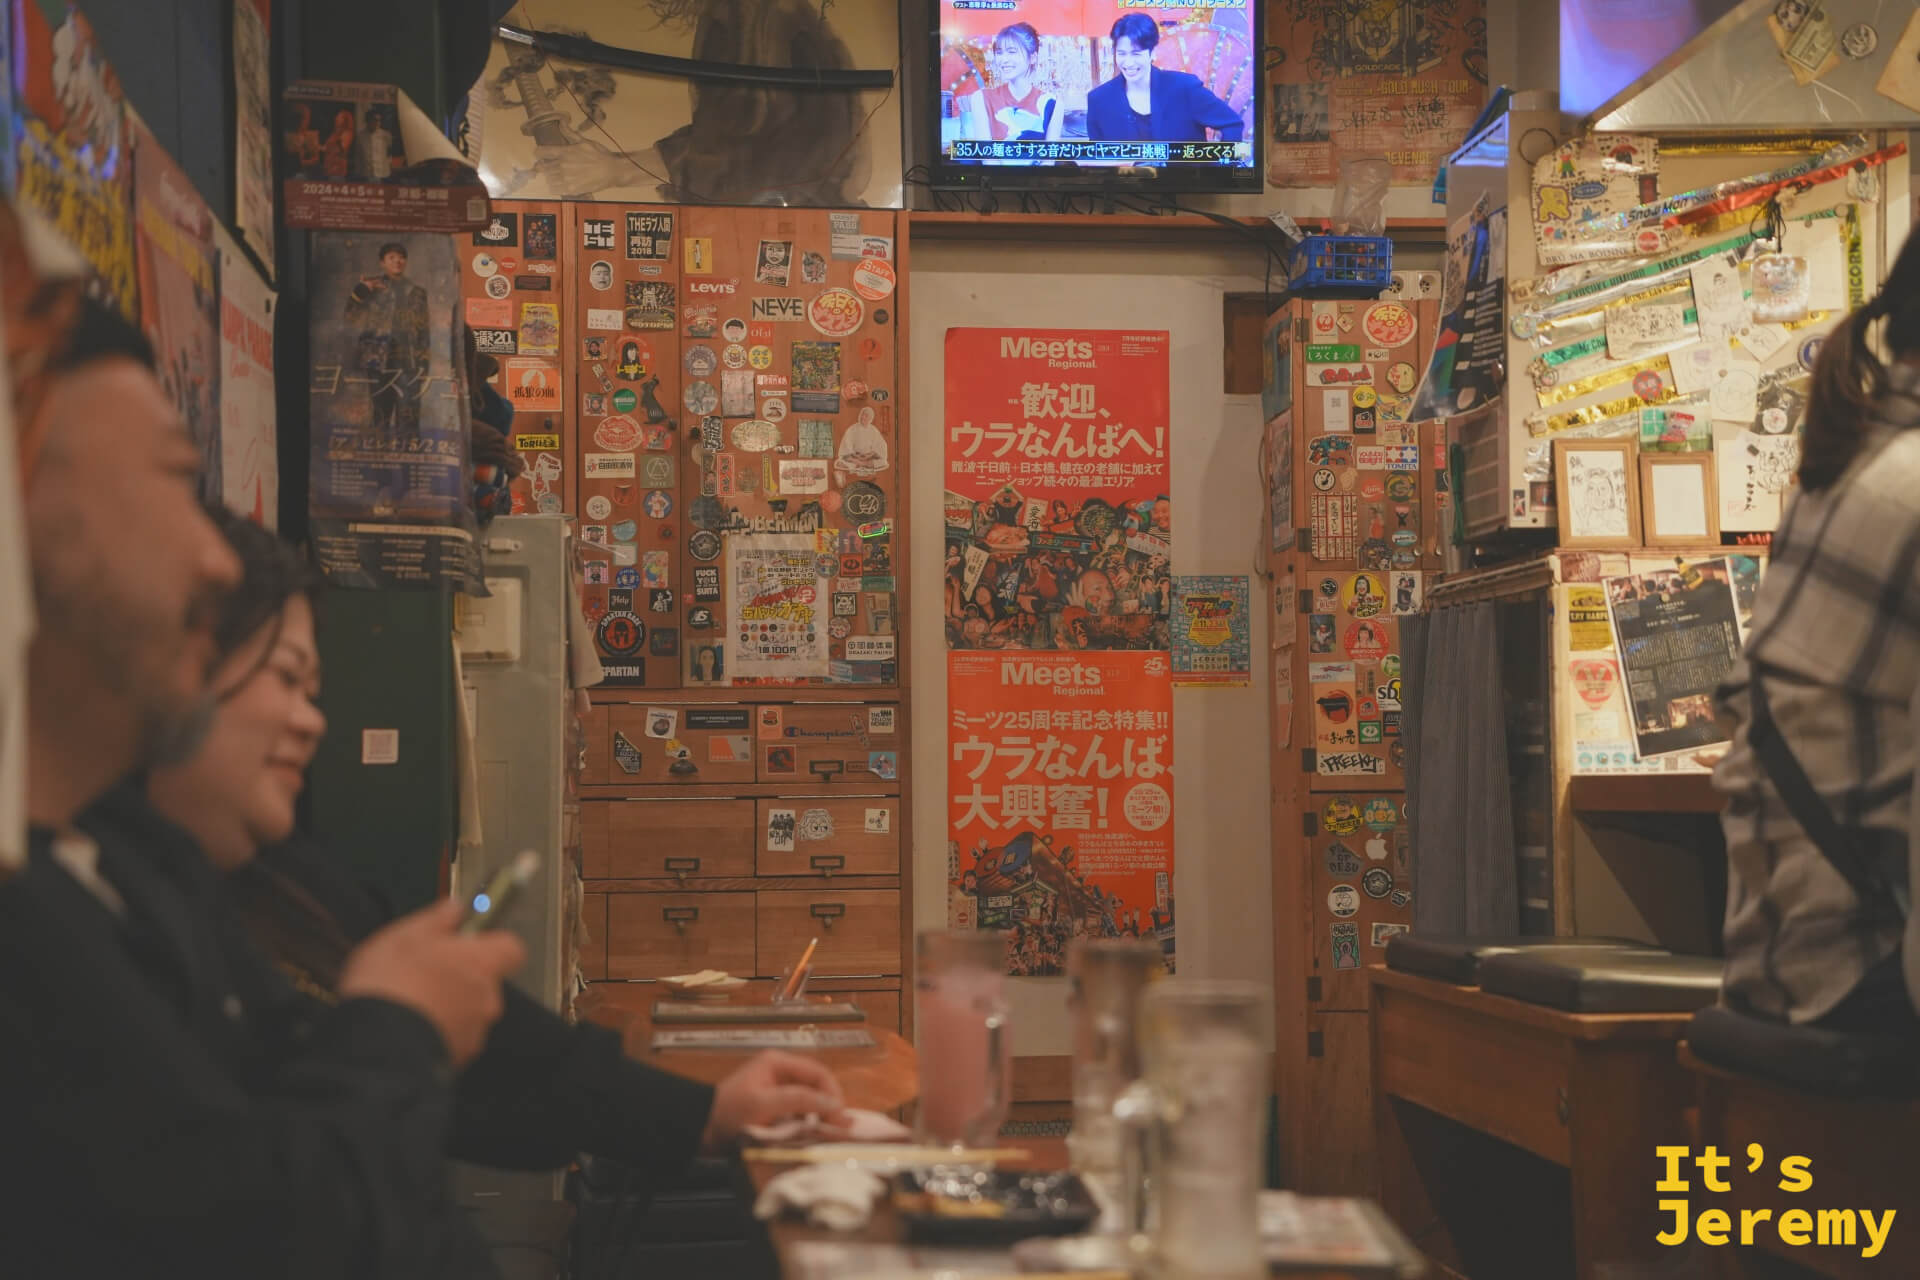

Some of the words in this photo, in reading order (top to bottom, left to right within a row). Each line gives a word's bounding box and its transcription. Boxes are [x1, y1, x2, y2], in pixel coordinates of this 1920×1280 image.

[752, 298, 803, 318] NEVE
[1000, 336, 1093, 359] Meets
[1001, 662, 1101, 686] Meets
[784, 726, 856, 741] Champion
